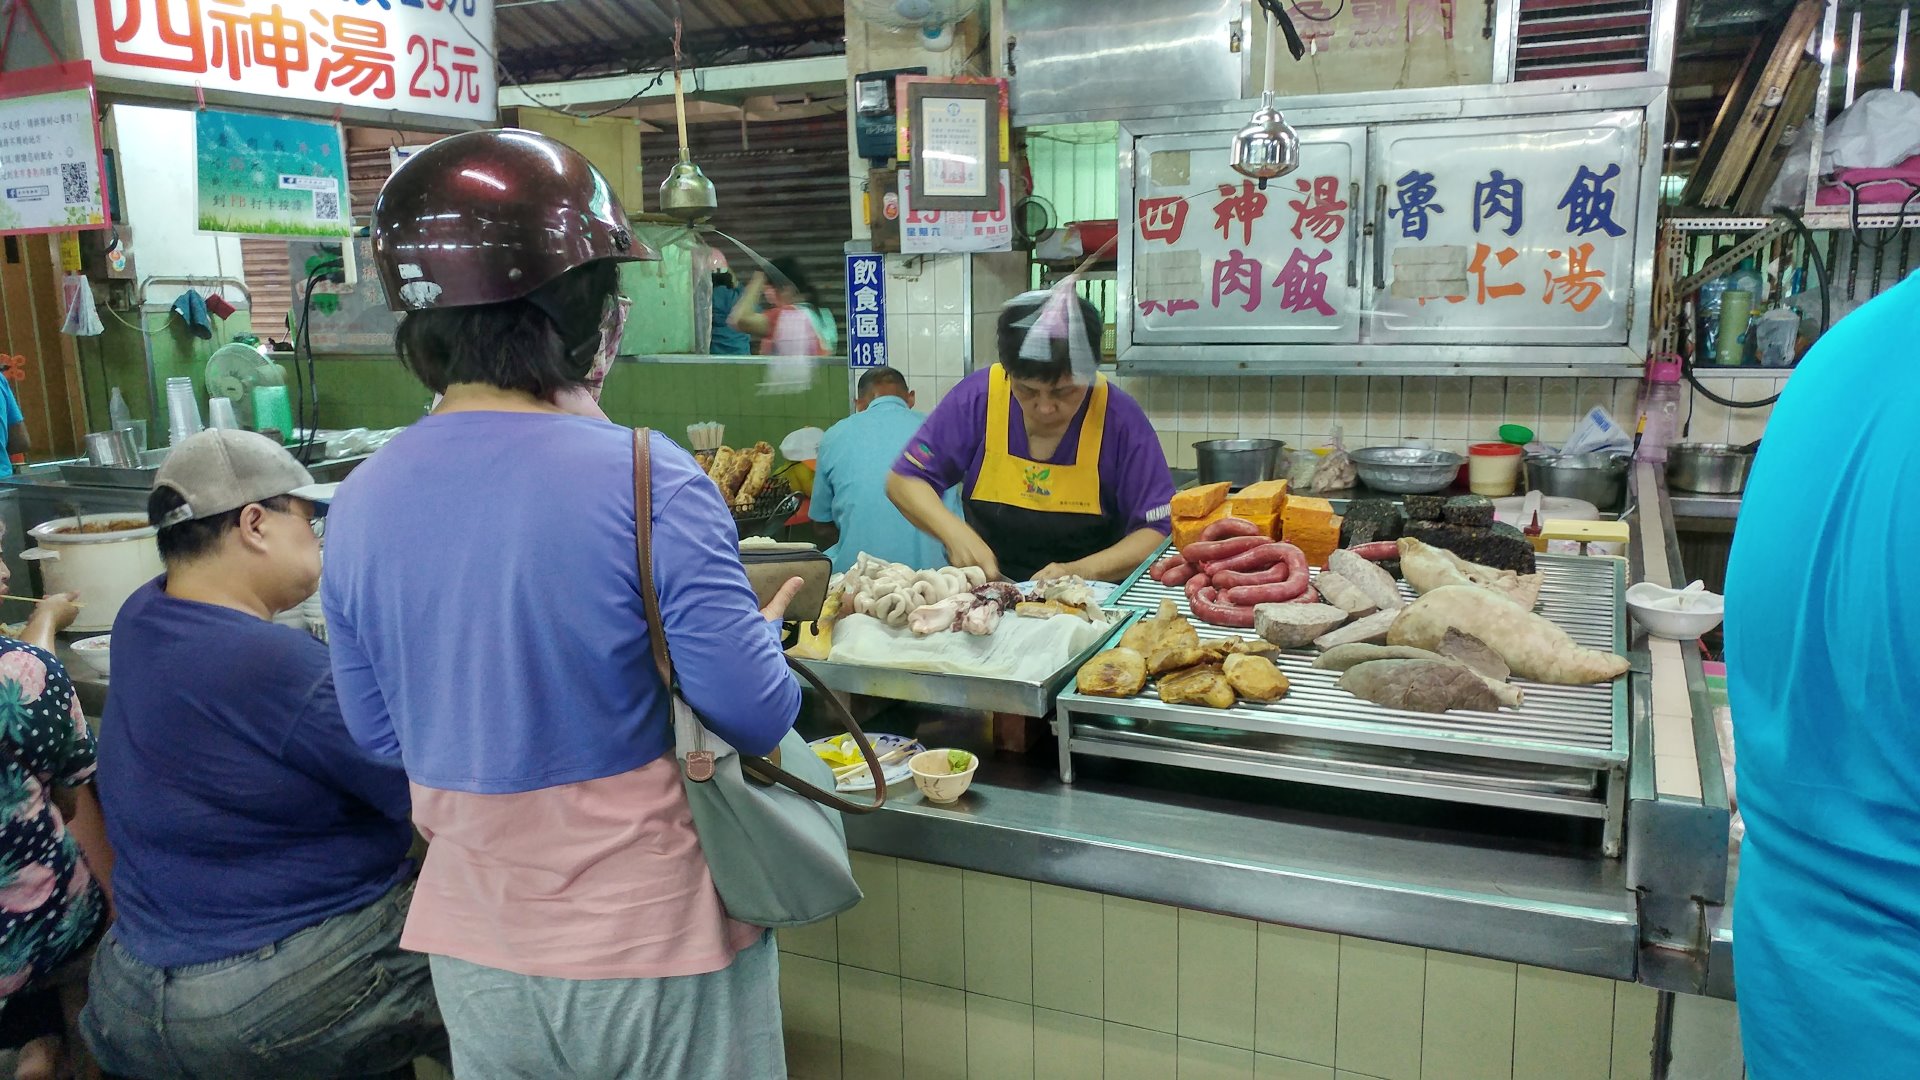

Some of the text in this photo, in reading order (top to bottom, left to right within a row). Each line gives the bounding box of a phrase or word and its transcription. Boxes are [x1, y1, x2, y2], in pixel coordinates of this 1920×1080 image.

[95, 0, 479, 103] 四神湯 25元
[974, 225, 1009, 236] 星期日
[1138, 163, 1627, 247] 四神湯 魯肉飯
[853, 259, 879, 338] 飲食區
[1138, 243, 1606, 316] 肉飯 仁湯
[854, 342, 885, 365] 18號
